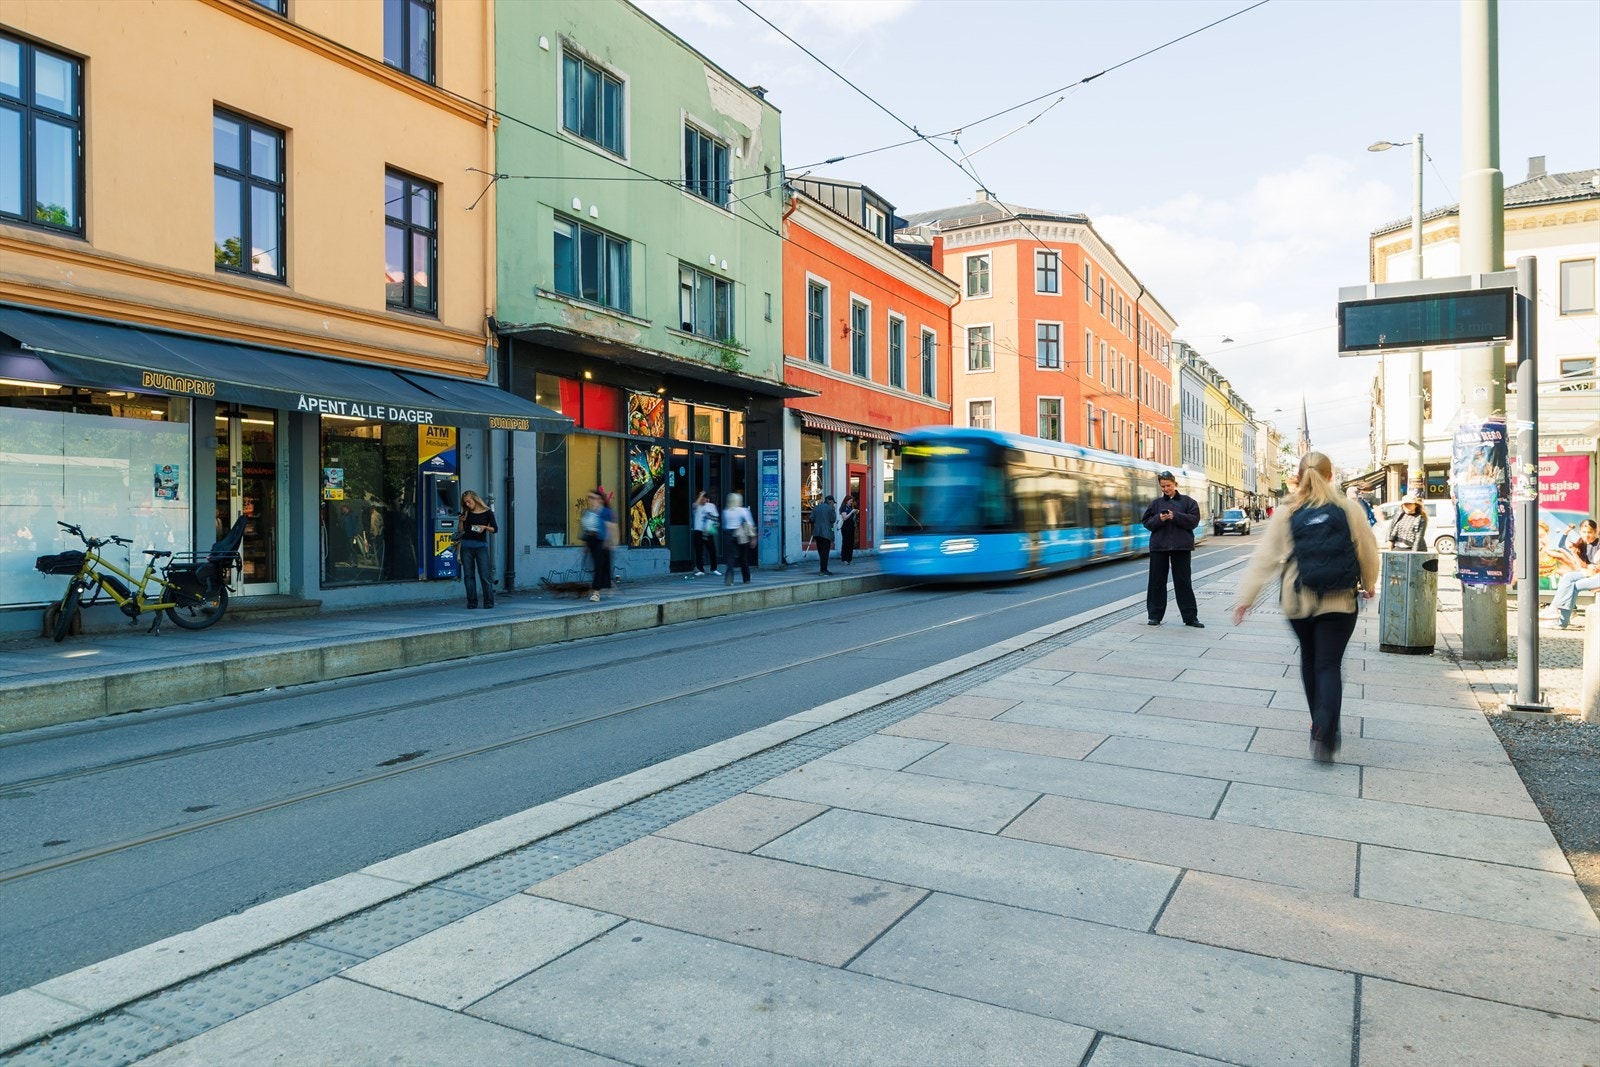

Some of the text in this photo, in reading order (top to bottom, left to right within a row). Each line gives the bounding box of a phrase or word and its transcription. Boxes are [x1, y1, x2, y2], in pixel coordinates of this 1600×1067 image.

[142, 371, 215, 396] BUNNPRIS
[297, 394, 433, 424] ÅPENT ALLE DAGER
[489, 416, 530, 431] BUNNPRIS
[426, 426, 449, 438] ATM
[425, 440, 449, 448] Minibank
[1550, 480, 1581, 492] spise
[1539, 492, 1567, 504] juni?
